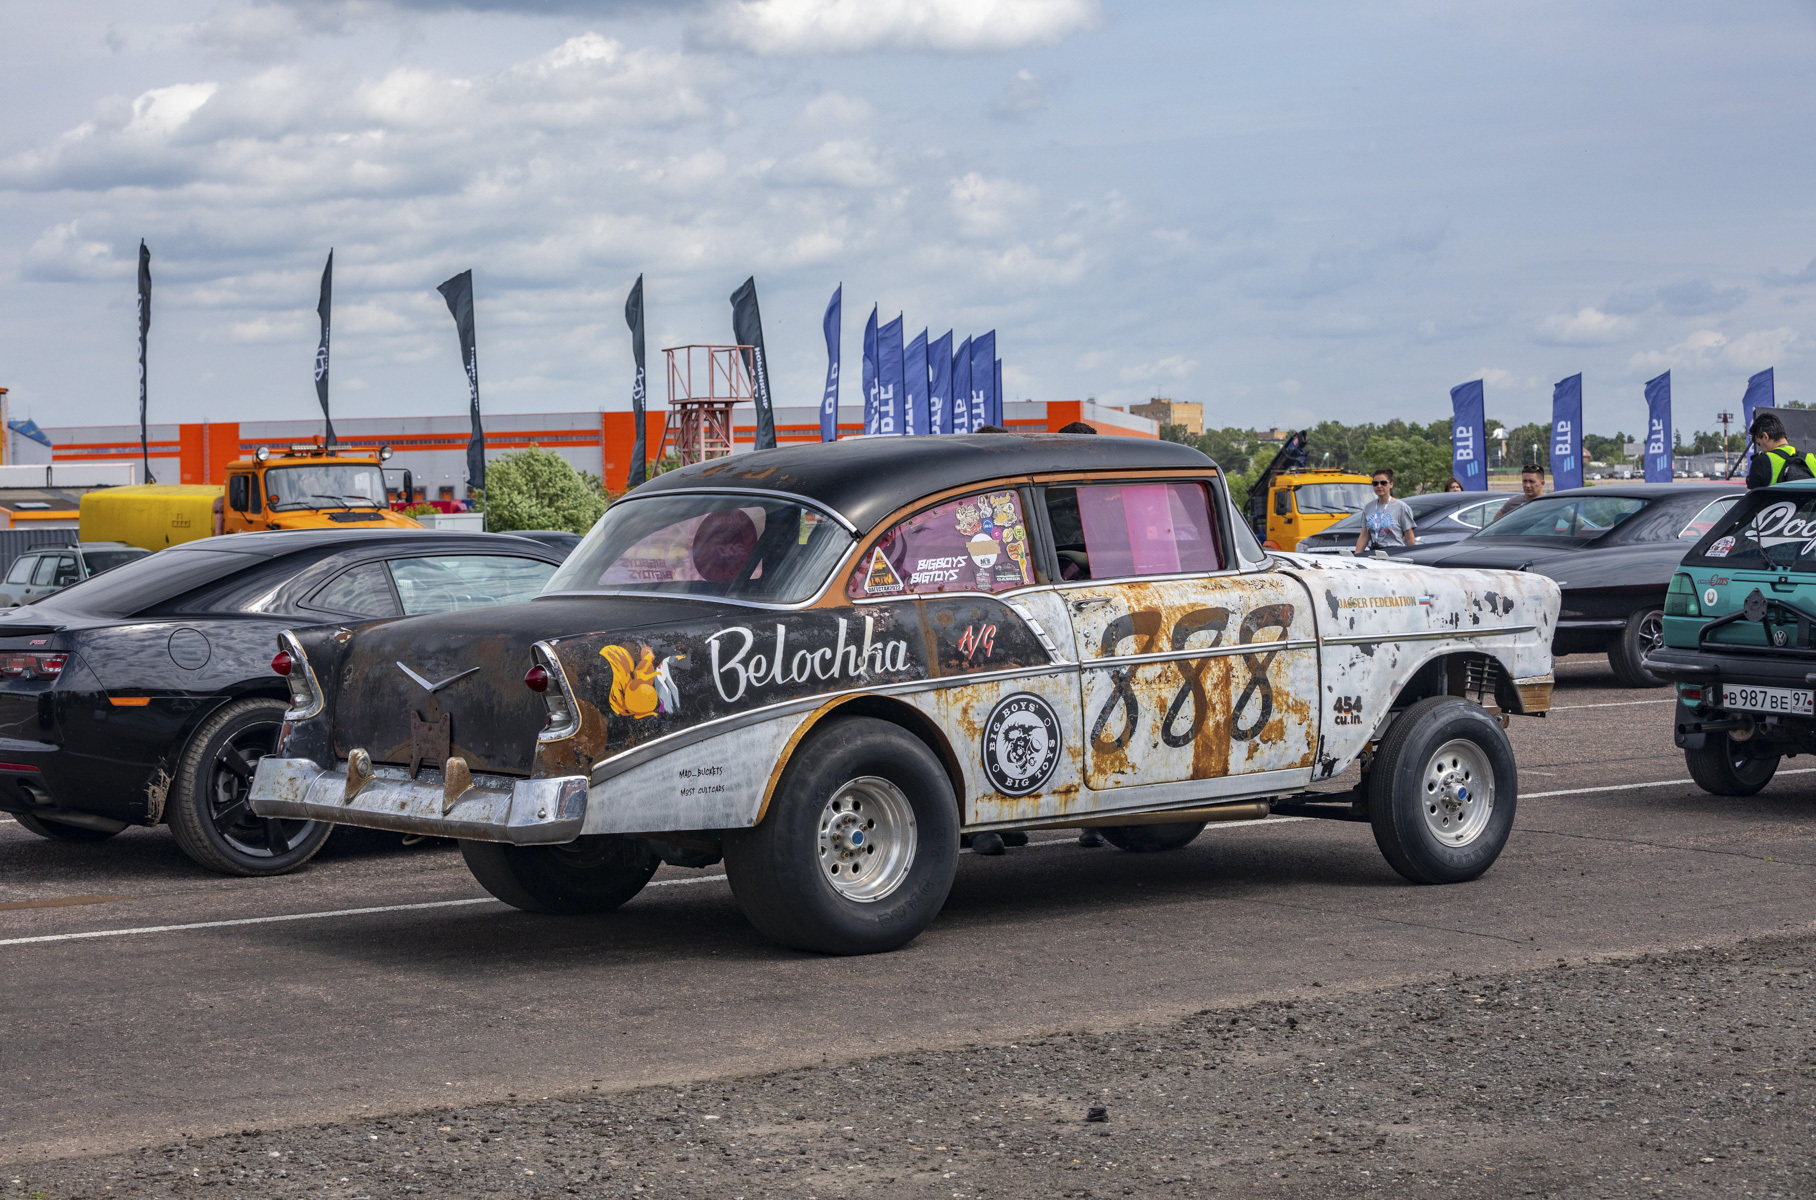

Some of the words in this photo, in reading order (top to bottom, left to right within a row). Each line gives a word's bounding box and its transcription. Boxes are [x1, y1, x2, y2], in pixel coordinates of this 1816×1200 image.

[917, 556, 968, 571] BIGBOYS
[910, 569, 959, 584] BIGTOYS
[1710, 574, 1729, 587] Cars
[1338, 597, 1368, 609] GASSER
[1369, 596, 1417, 608] FEDERATION
[958, 624, 996, 660] A/G
[705, 616, 911, 703] Belochka
[1090, 604, 1295, 755] 888
[1333, 696, 1363, 715] 454
[1793, 692, 1808, 706] 97
[989, 722, 1001, 751] BIG
[1005, 778, 1030, 787] BIG
[1035, 739, 1056, 779] TOYS
[679, 766, 723, 778] MAD_BUCKETS
[680, 787, 696, 796] MOST
